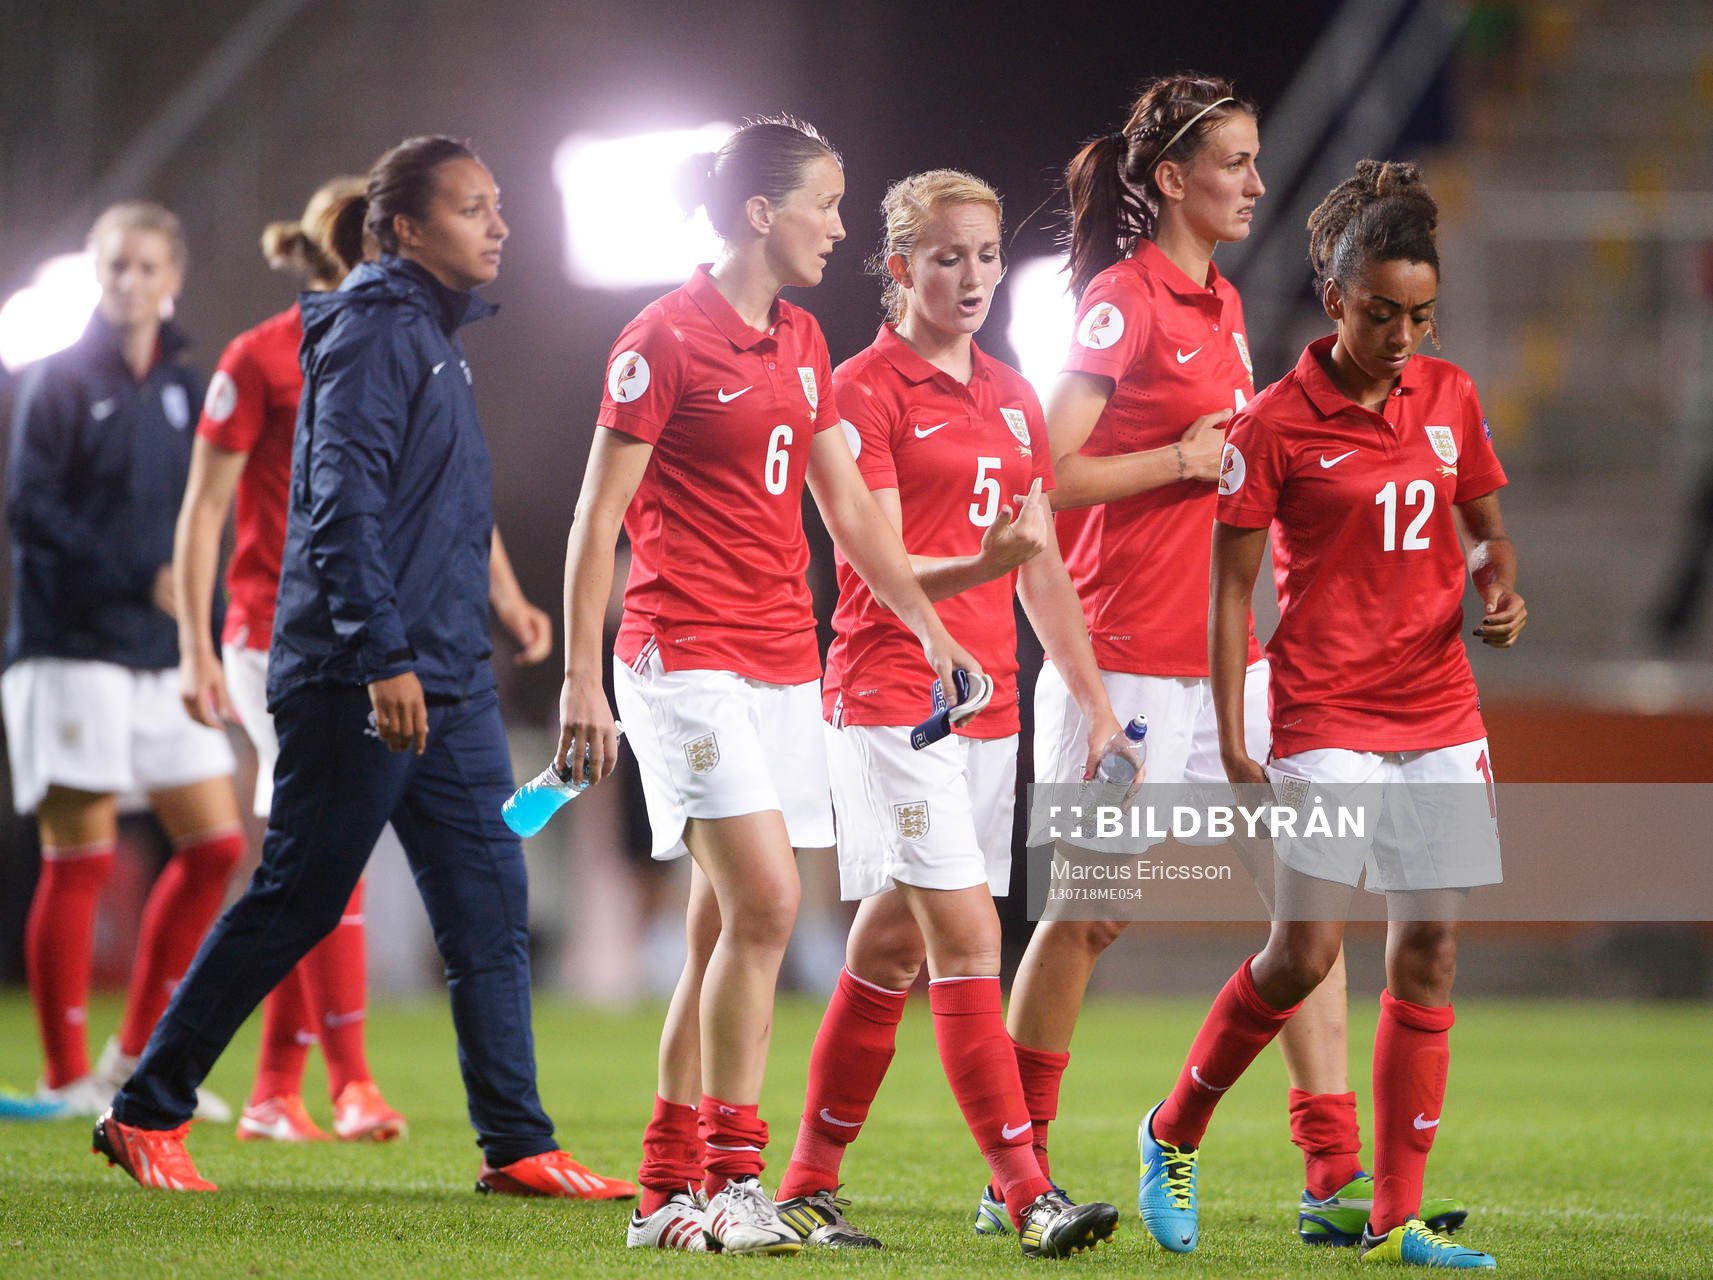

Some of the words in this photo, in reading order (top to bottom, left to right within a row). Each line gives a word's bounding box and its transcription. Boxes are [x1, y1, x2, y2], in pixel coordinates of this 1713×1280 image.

[764, 424, 794, 496] 6
[968, 456, 1002, 528] 5
[1375, 479, 1436, 552] 12
[1475, 749, 1500, 839] 1
